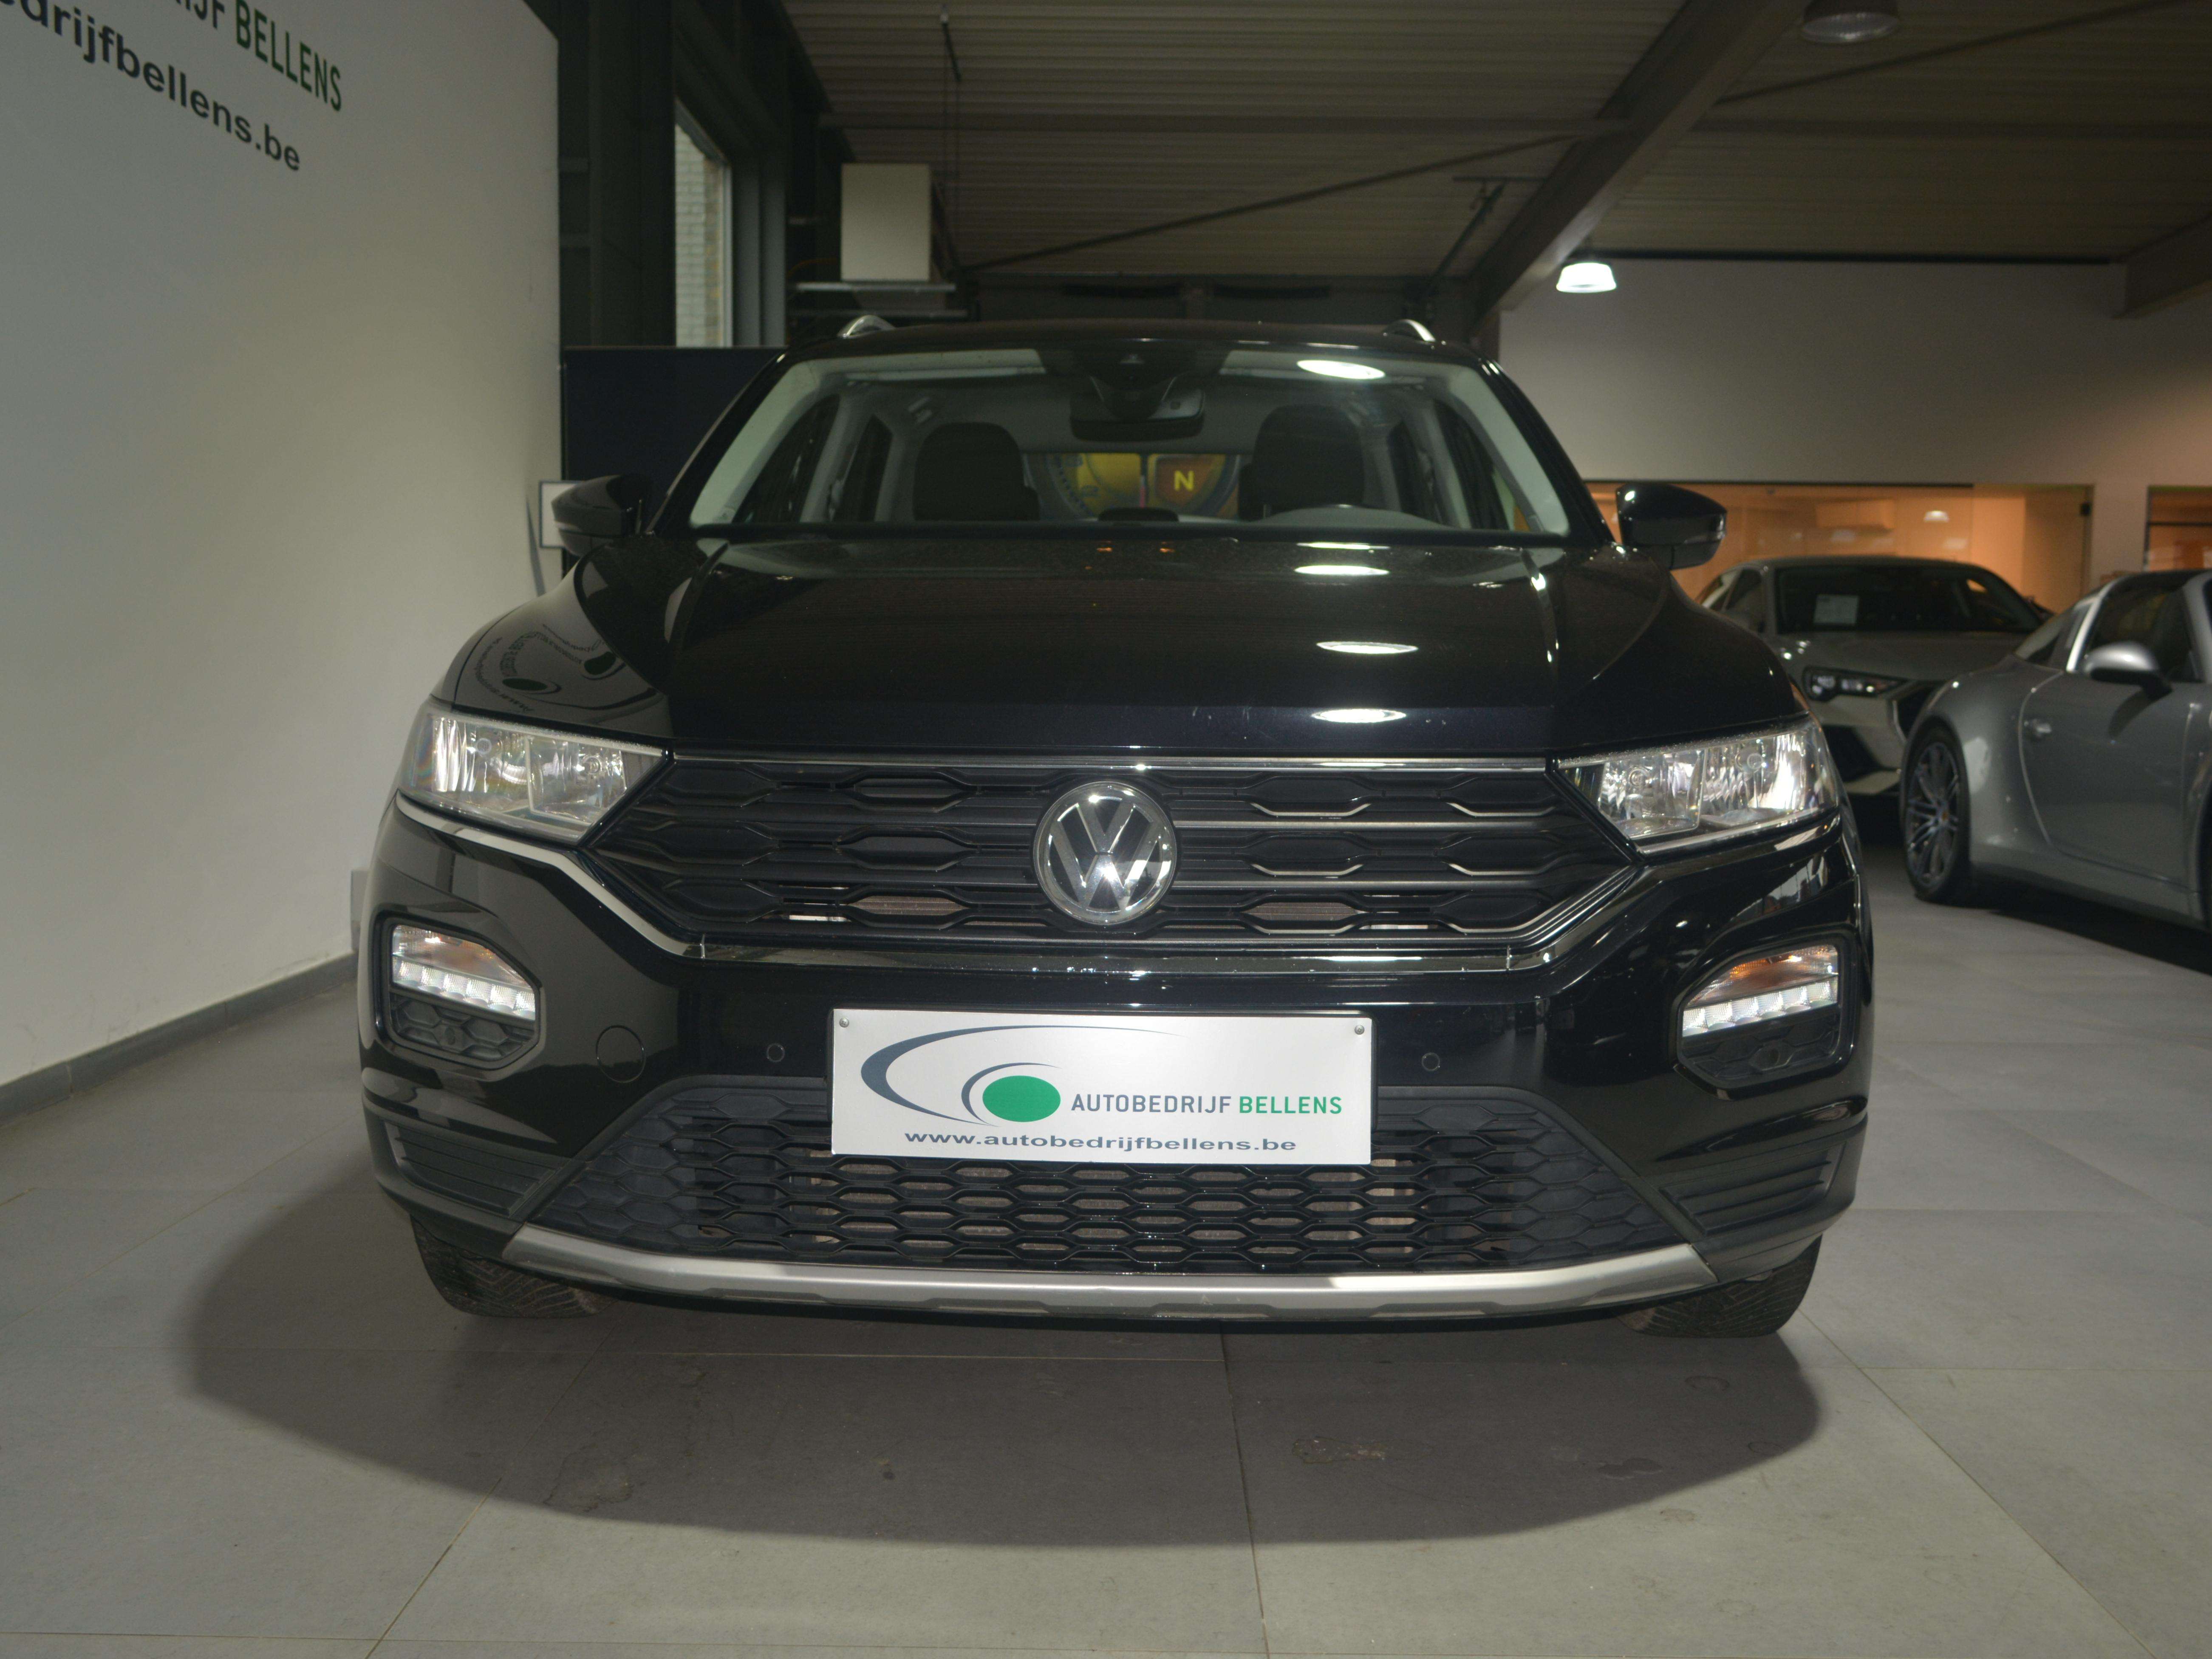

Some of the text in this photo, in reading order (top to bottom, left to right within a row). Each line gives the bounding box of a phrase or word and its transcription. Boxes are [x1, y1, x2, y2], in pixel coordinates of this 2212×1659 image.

[235, 0, 342, 112] BELLENS
[0, 0, 300, 171] drijfbellens.be
[1174, 470, 1195, 491] N
[1071, 1094, 1342, 1114] AUTOBEDRIJF BELLENS
[904, 1132, 1297, 1153] www.autobedrijfbellens.be
